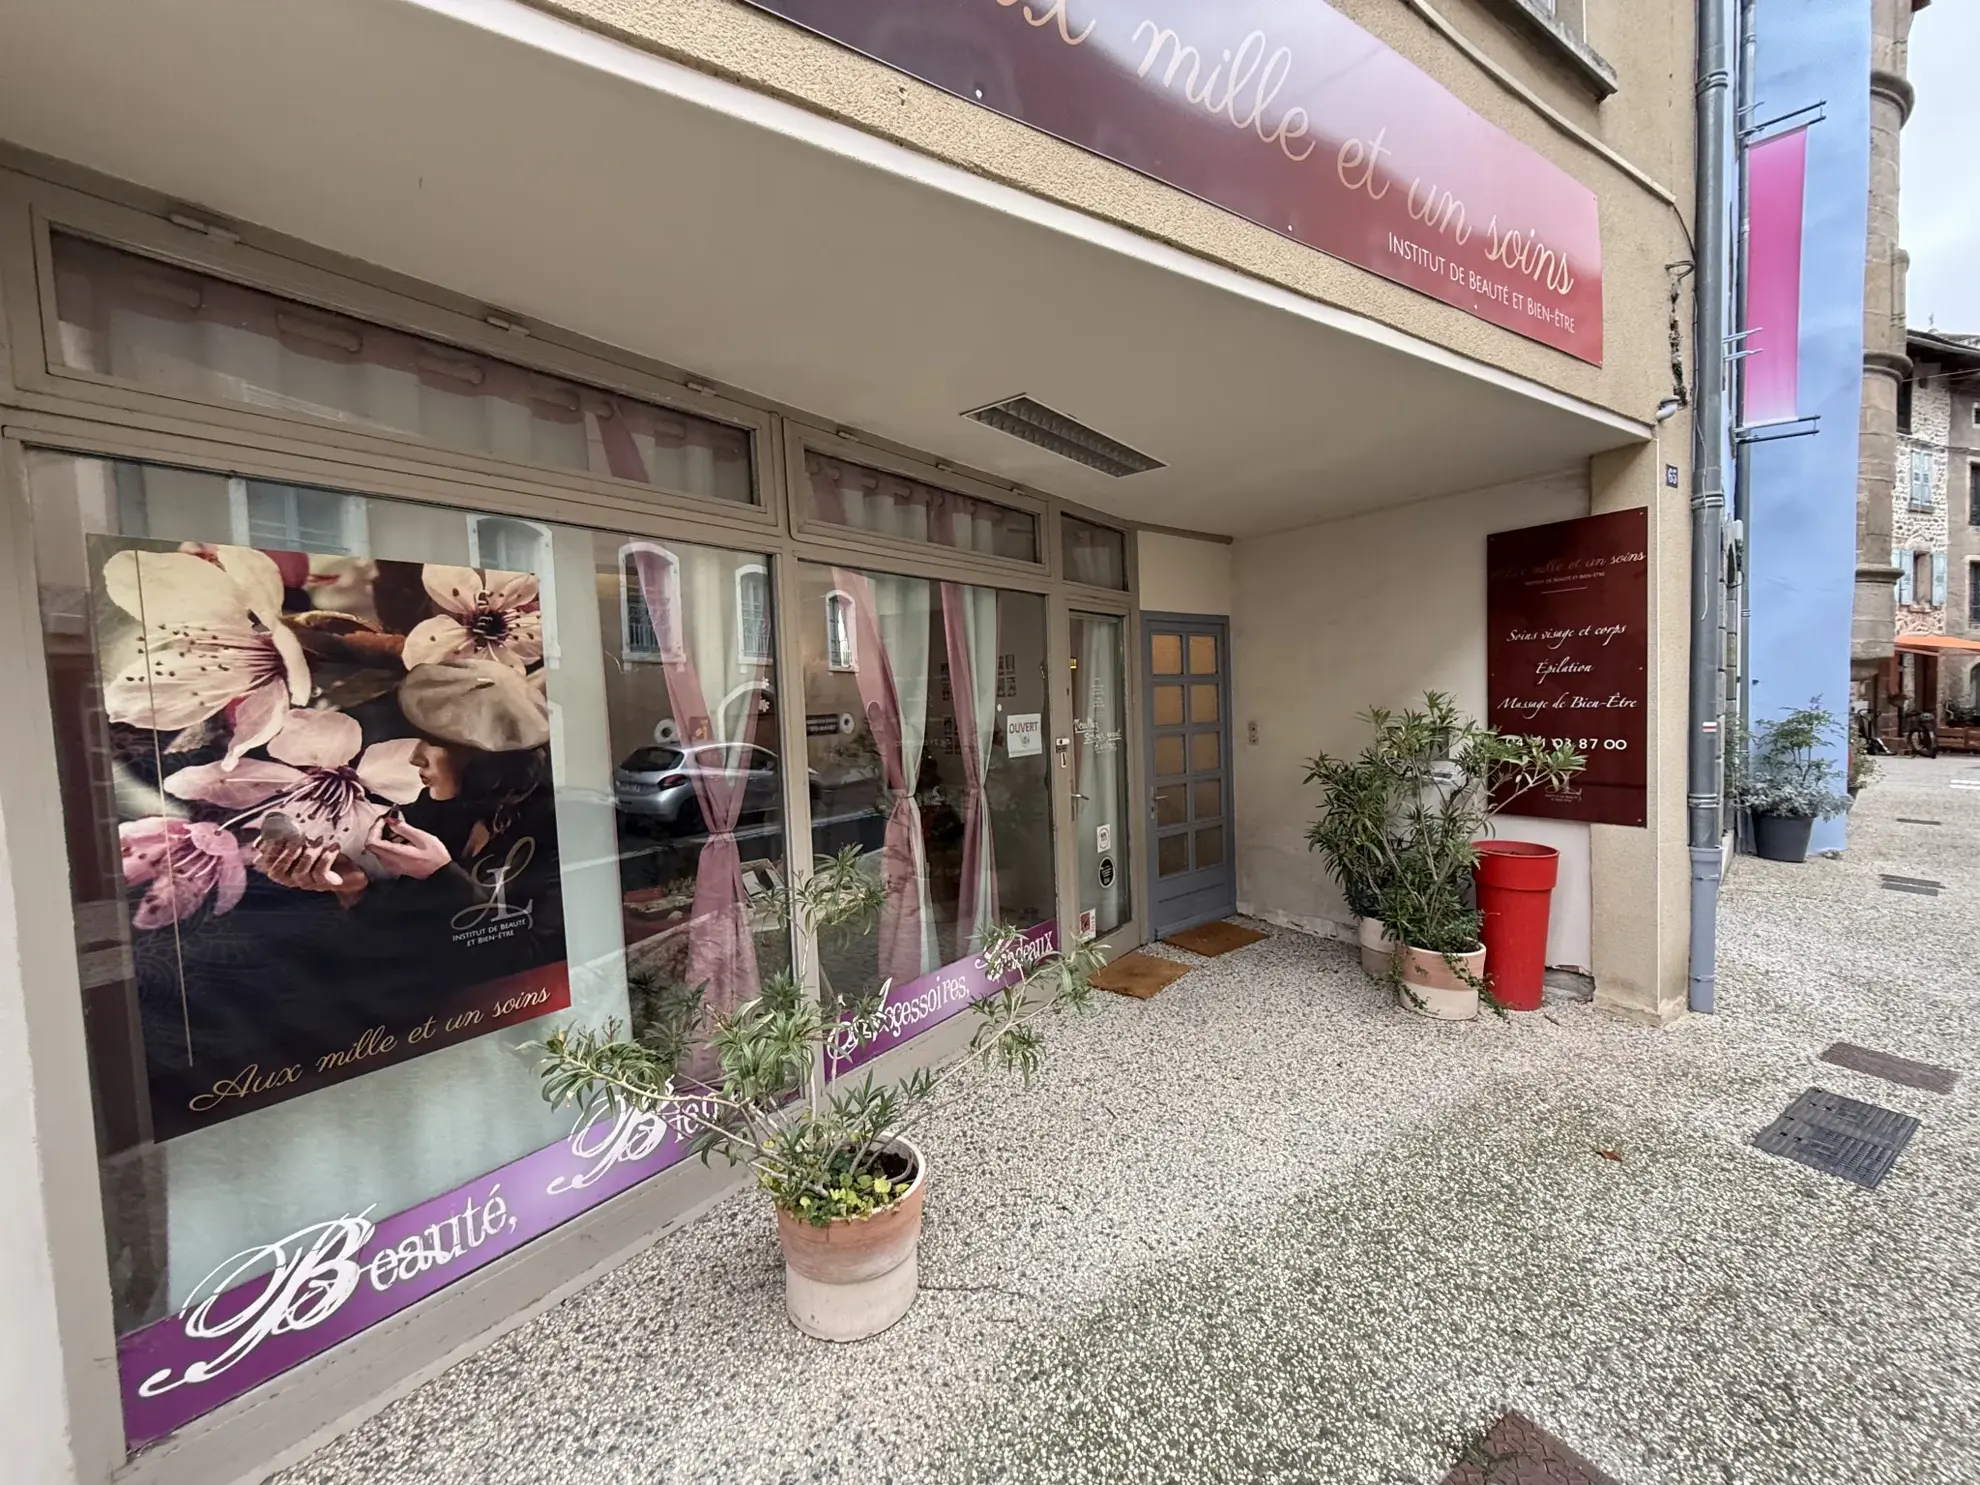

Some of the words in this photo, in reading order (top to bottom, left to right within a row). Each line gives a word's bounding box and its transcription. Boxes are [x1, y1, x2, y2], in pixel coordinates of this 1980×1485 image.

[1132, 19, 1316, 161] mille
[1337, 126, 1392, 200] et
[1407, 177, 1472, 246] un
[1484, 214, 1575, 296] soins
[1388, 231, 1446, 275] INSTITUT
[1450, 262, 1465, 286] DE
[1469, 270, 1509, 305] BEAUTÉ
[1512, 292, 1524, 311] ET
[1527, 297, 1575, 334] BIEN-ÊTRE
[1610, 551, 1646, 565] soins
[1506, 629, 1538, 642] Soins
[1541, 628, 1575, 650] visage
[1578, 625, 1593, 636] et
[1595, 624, 1627, 646] corps
[1497, 697, 1549, 720] Massage
[1552, 691, 1569, 709] de
[1570, 692, 1638, 709] Bien-Être
[1009, 721, 1039, 734] OUVERT
[1579, 738, 1598, 750] 87
[1604, 739, 1628, 750] 00
[453, 928, 486, 942] INSTITUT
[488, 925, 498, 934] DE
[467, 939, 475, 947] ET
[189, 1063, 303, 1112] Aux
[316, 1025, 398, 1073] mille
[408, 1016, 436, 1044] et
[445, 1009, 485, 1033] un
[492, 986, 551, 1018] soins
[138, 1183, 518, 1398] Beauté,
